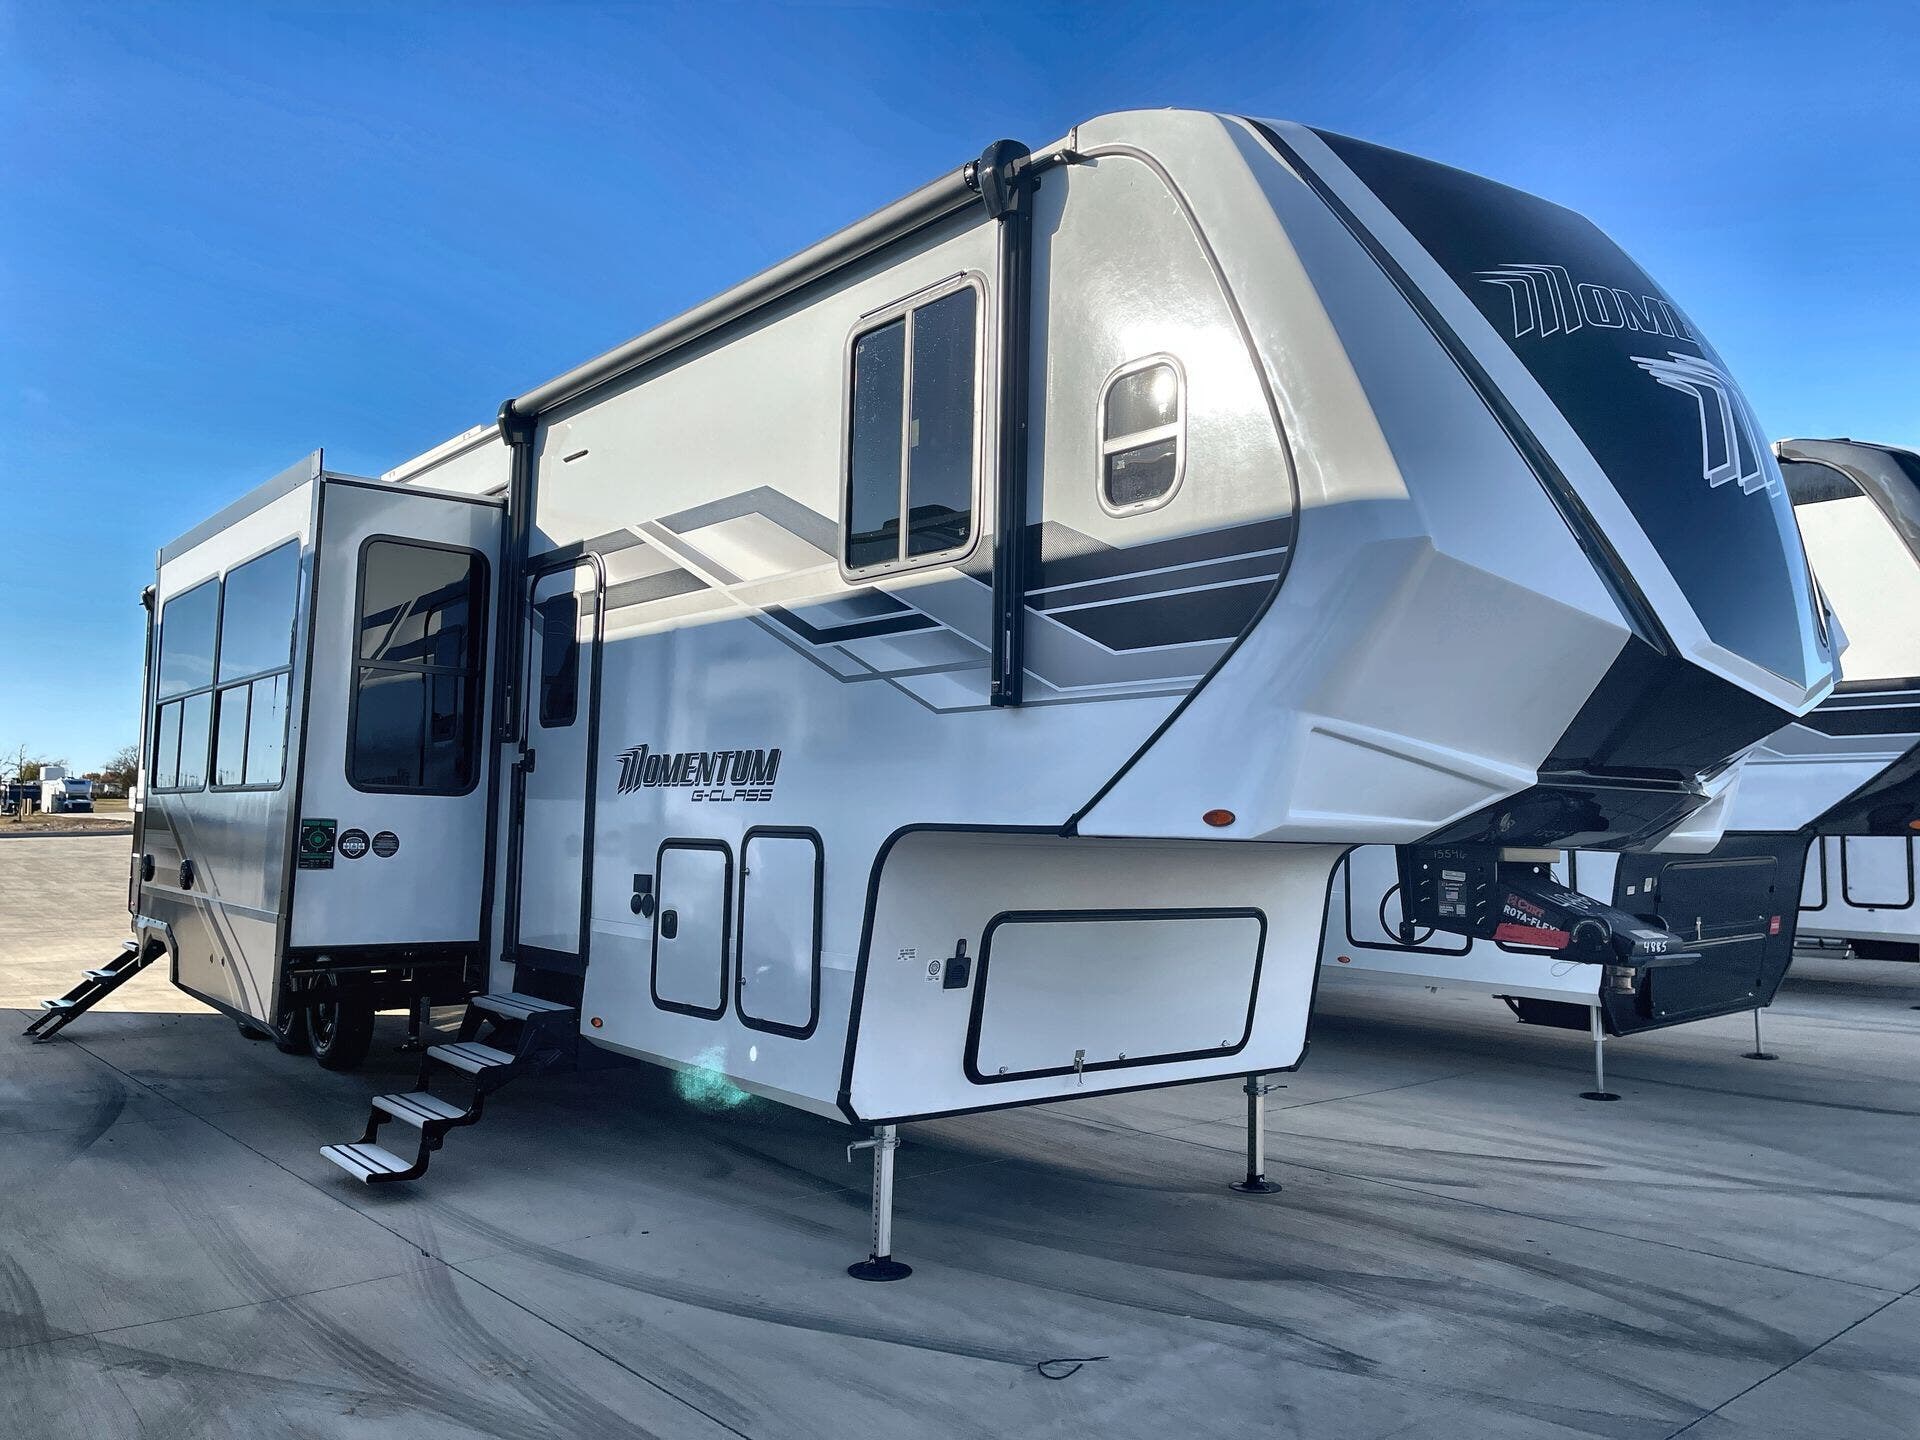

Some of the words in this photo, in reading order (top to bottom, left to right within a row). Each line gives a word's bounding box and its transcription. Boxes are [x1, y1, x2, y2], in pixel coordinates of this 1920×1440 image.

[614, 743, 782, 795] MOMENTUM
[691, 789, 773, 802] G-CLASS
[1643, 940, 1668, 953] 4885
